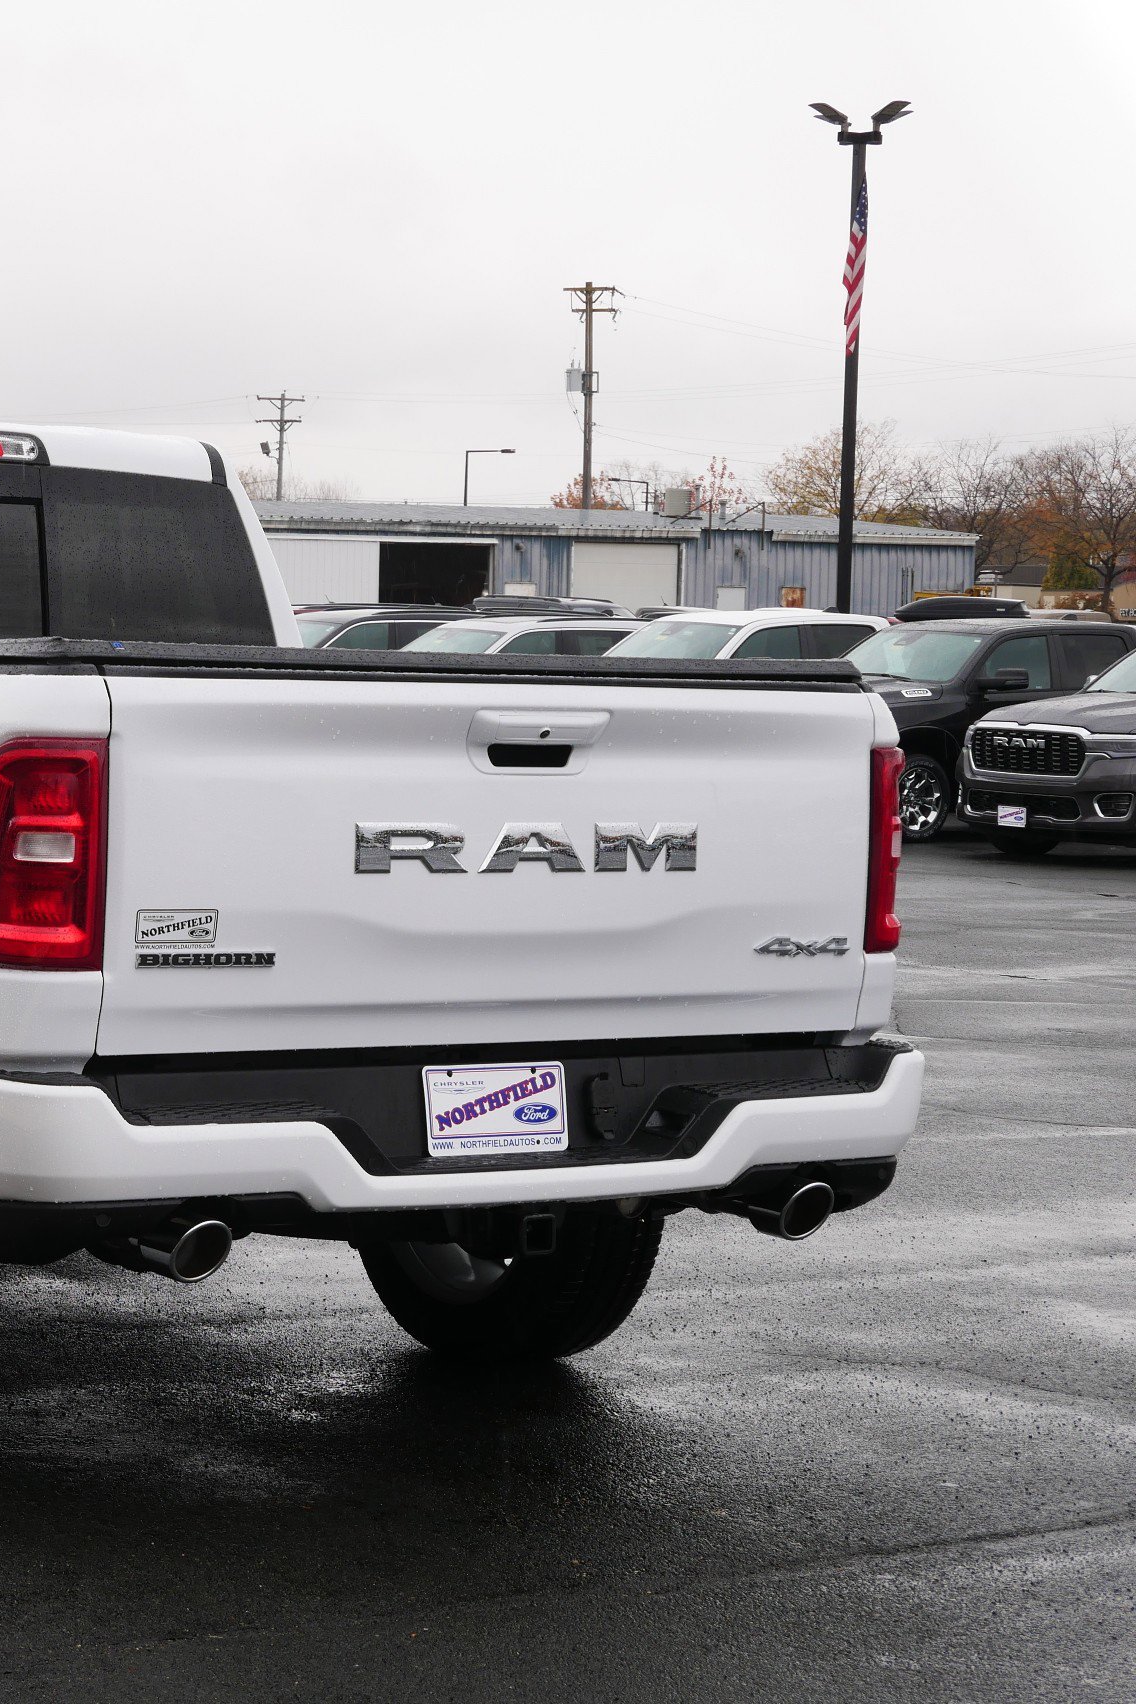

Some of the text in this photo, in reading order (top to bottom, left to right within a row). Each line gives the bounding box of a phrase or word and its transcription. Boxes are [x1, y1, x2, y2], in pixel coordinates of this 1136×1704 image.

[993, 736, 1046, 749] RAM
[355, 822, 698, 874] RAM
[141, 915, 213, 938] NORTHFIELD
[135, 952, 276, 969] BIGHORN
[435, 1071, 556, 1131] NORTHFIELD
[521, 1105, 550, 1120] Ford
